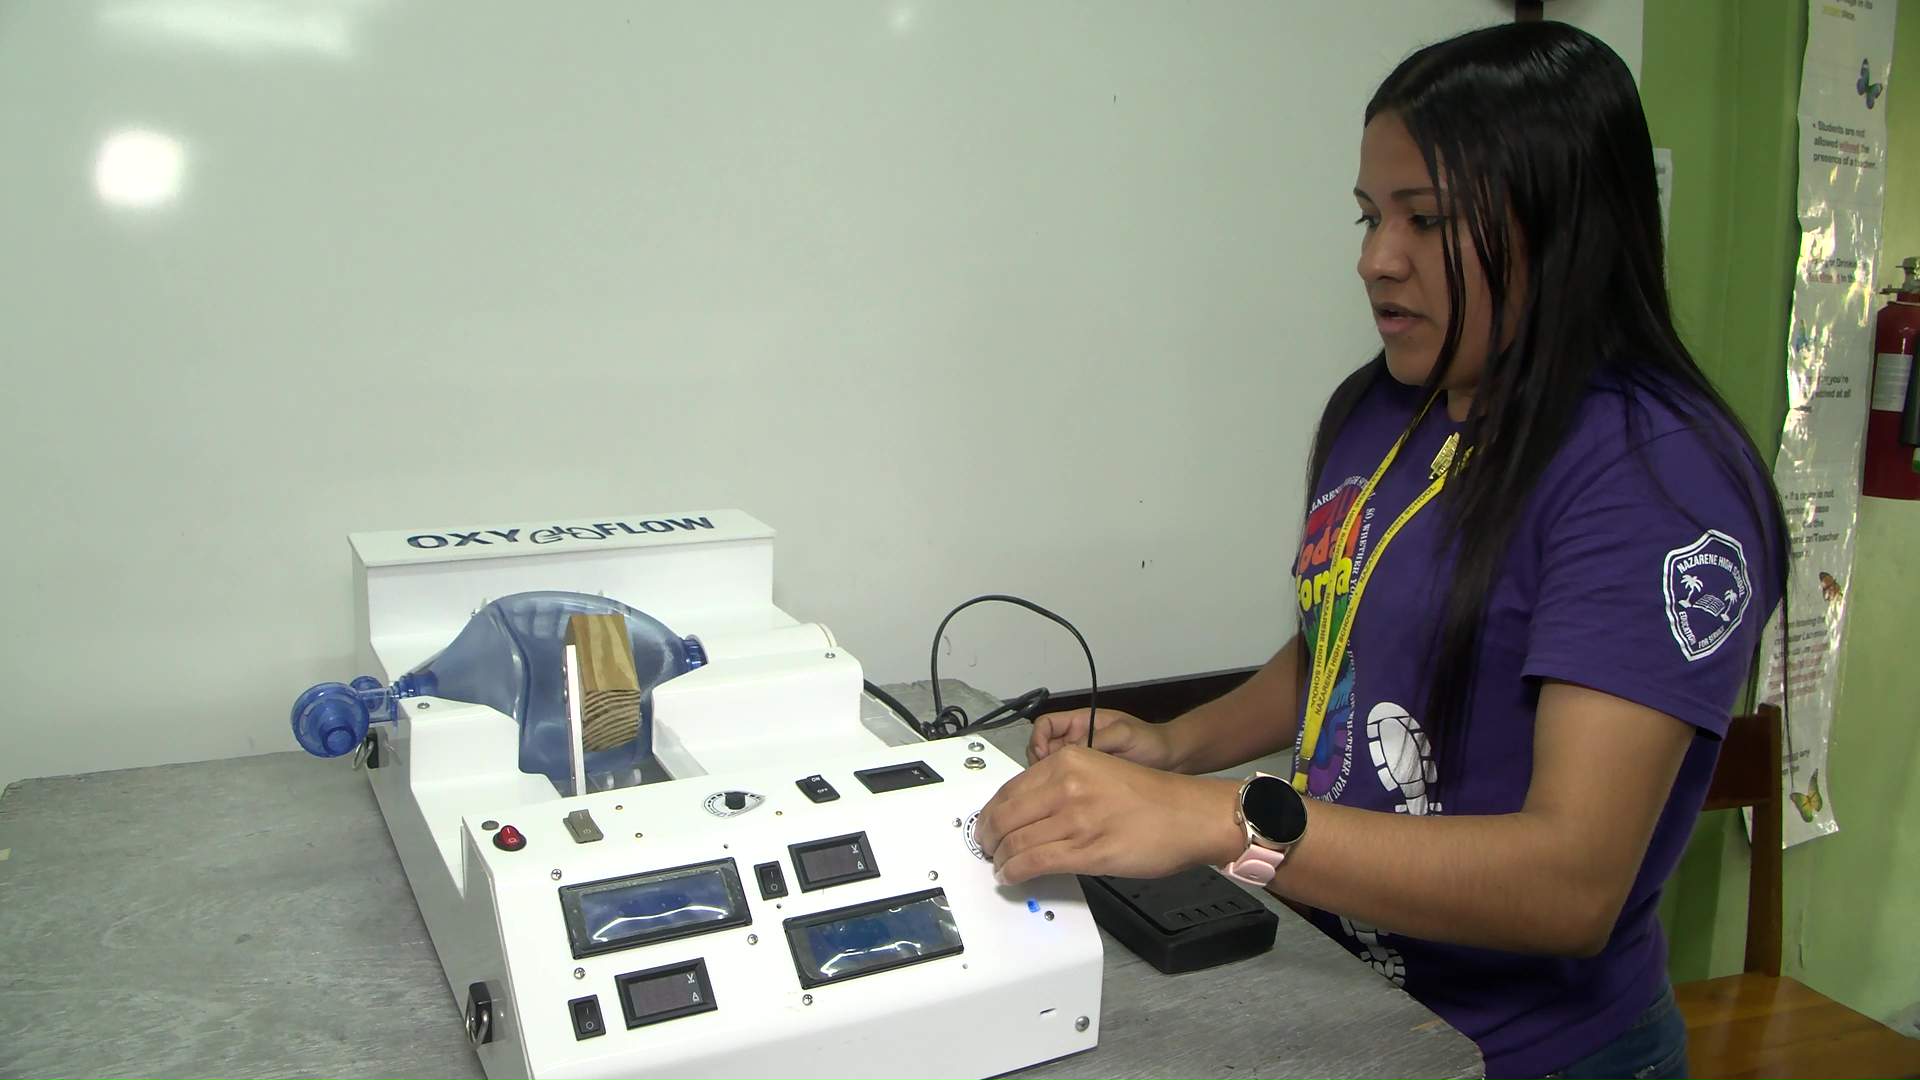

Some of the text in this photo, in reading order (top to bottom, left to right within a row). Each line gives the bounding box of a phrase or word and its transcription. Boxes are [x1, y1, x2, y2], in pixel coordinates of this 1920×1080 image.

[406, 528, 520, 548] OXY
[593, 516, 715, 536] FLOW
[1353, 523, 1371, 575] WHETHER
[1676, 554, 1746, 598] NAZARENE HIGH SCHOOL
[1698, 637, 1710, 649] FOR
[1316, 668, 1334, 715] NAZARENE
[1331, 644, 1342, 667] HIGH
[1331, 775, 1347, 799] YOU
